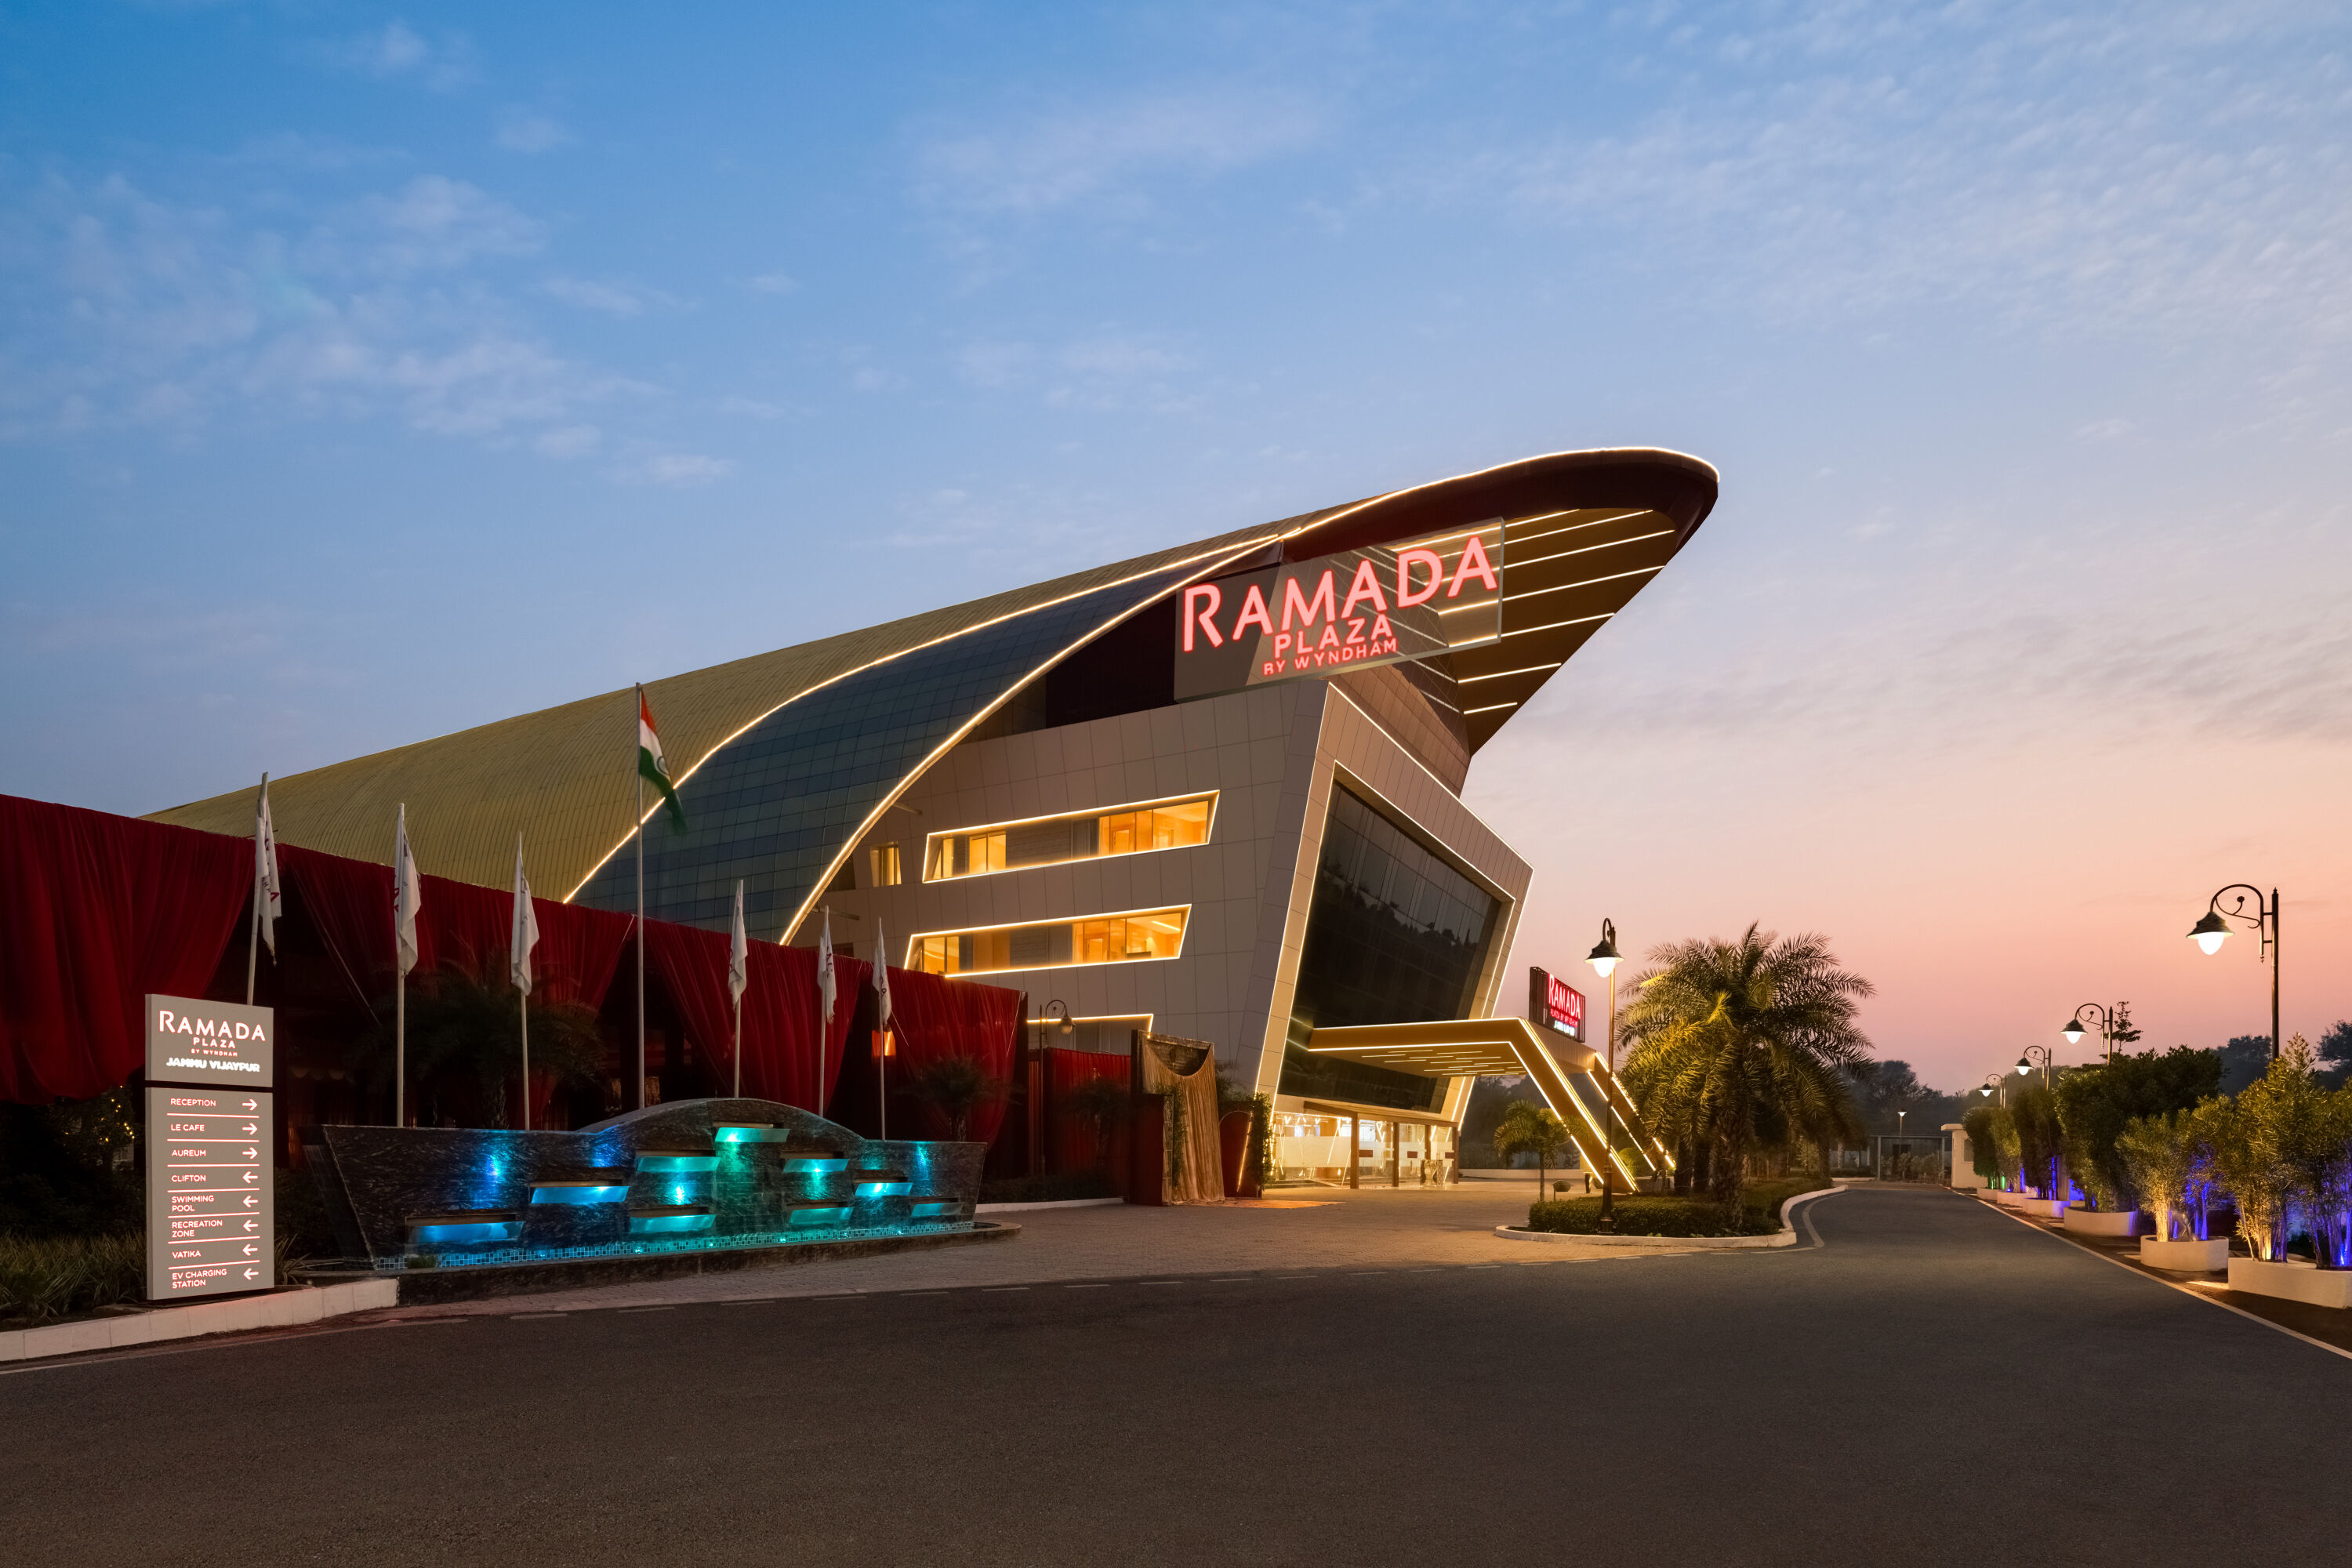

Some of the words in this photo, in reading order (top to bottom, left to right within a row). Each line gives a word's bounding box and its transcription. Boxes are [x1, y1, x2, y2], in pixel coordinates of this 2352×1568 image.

[1183, 536, 1497, 652] RAMADA
[1274, 614, 1393, 659] PLAZA
[1263, 660, 1284, 676] BY
[1294, 637, 1397, 670] WYNDHAM
[1548, 974, 1581, 1020] RAMADA
[159, 1010, 266, 1041] RAMADA
[193, 1036, 236, 1049] PLAZA
[166, 1058, 207, 1069] JAMMU
[209, 1060, 260, 1073] VIJAYPUR
[170, 1098, 216, 1107] RECEPTION
[172, 1195, 215, 1203] SWIMMING
[172, 1220, 223, 1229] RECREATION
[172, 1229, 195, 1238] ZONE
[172, 1250, 201, 1259] VATIKA
[185, 1269, 227, 1279] CHARGING
[172, 1279, 206, 1289] STATION
